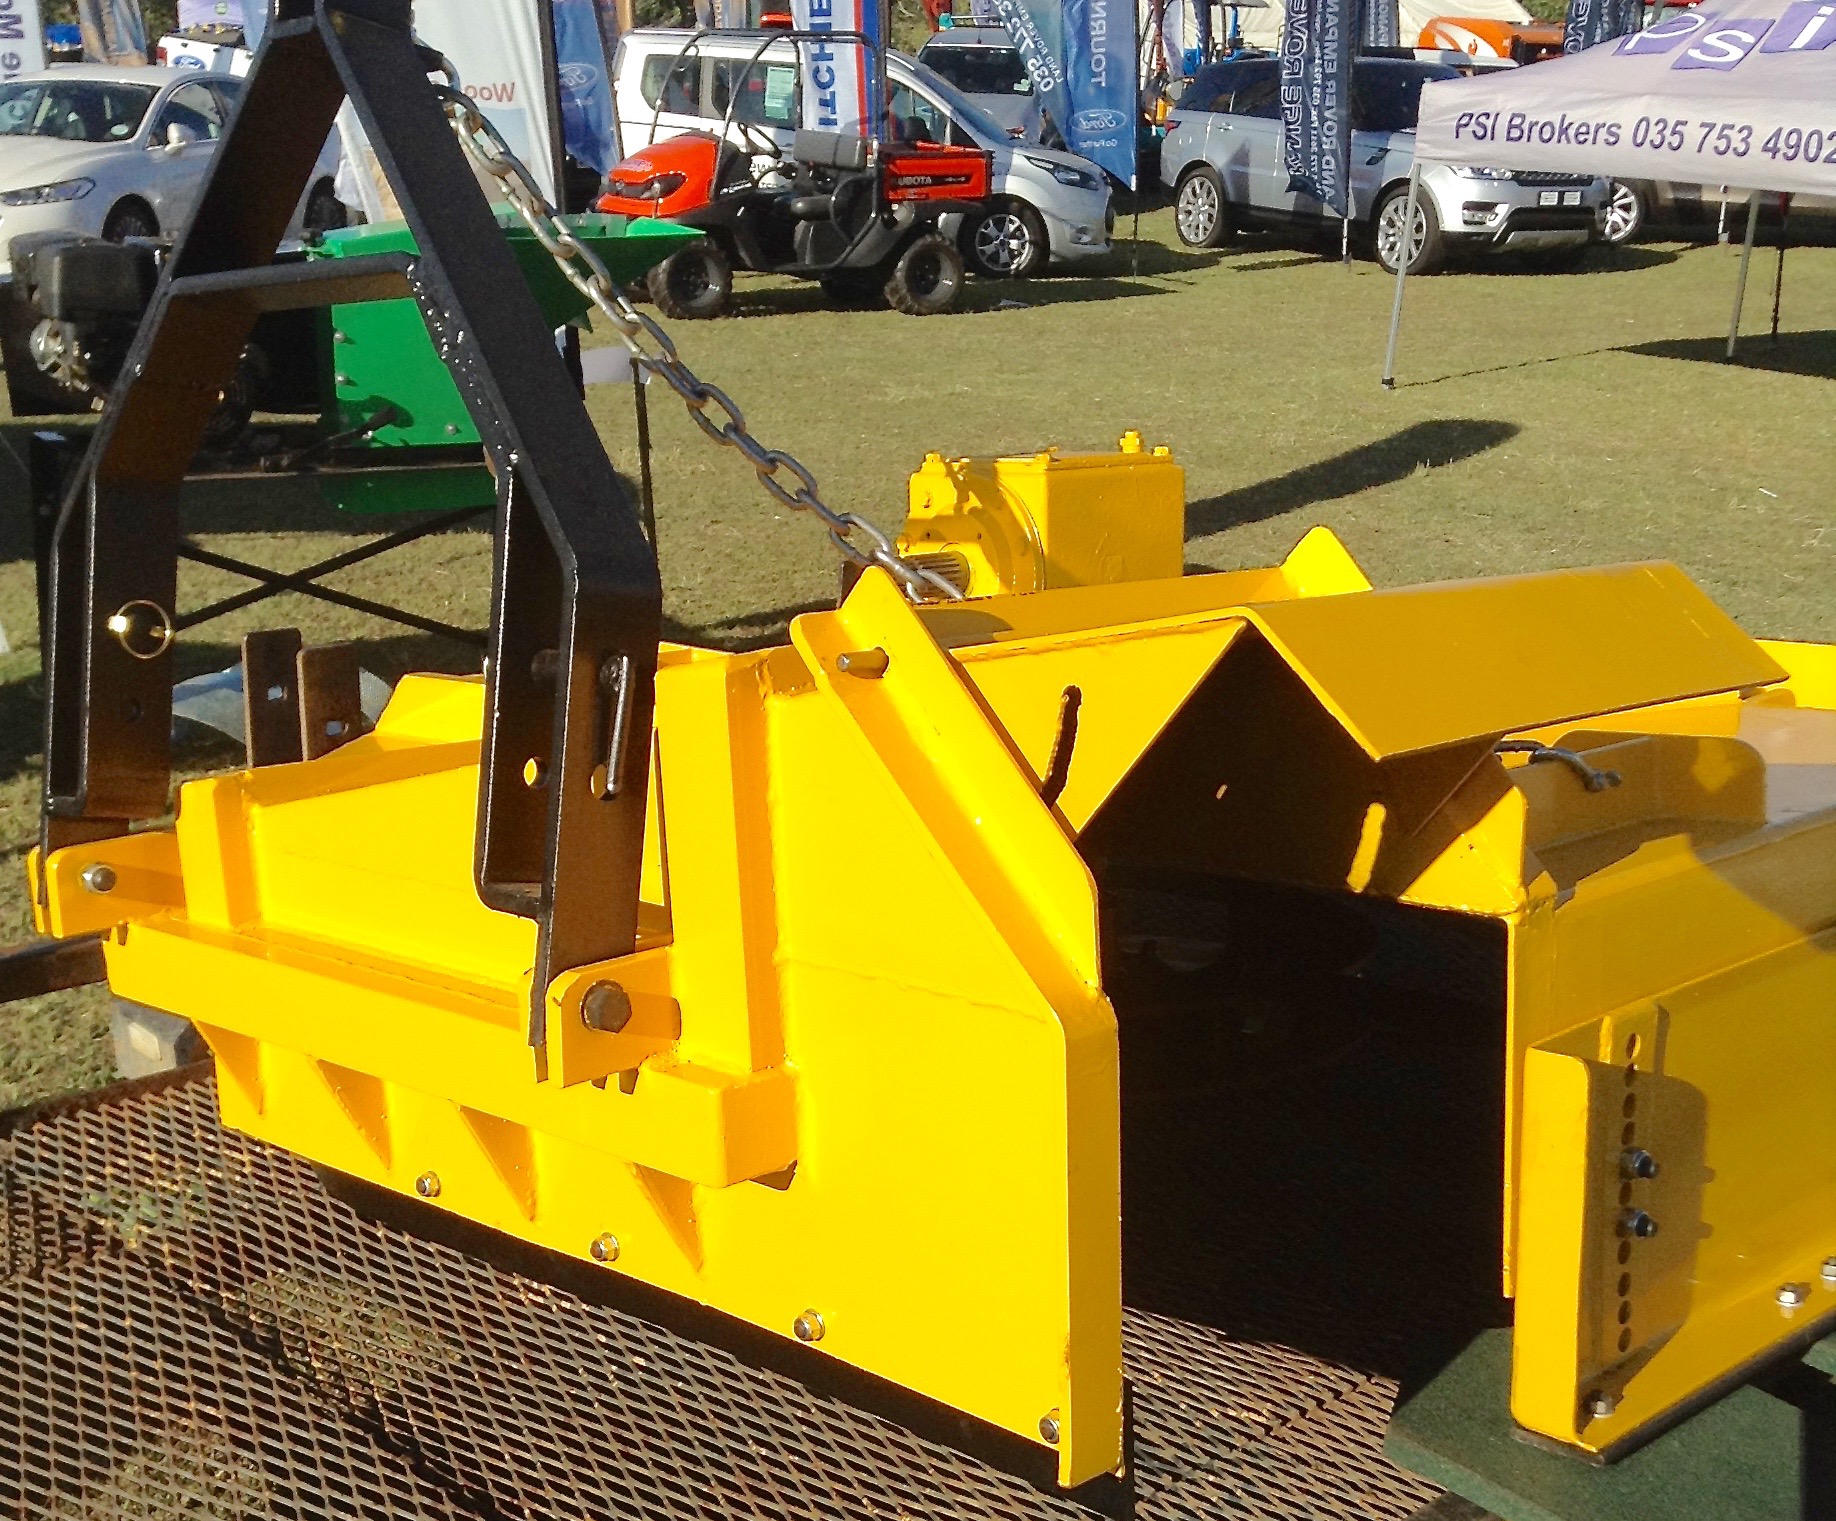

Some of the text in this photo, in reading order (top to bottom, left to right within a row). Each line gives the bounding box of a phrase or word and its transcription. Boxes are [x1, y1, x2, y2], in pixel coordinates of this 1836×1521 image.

[1455, 112, 1836, 164] PSI Brokers 035 753 4902
[895, 176, 932, 186] UBOTA
